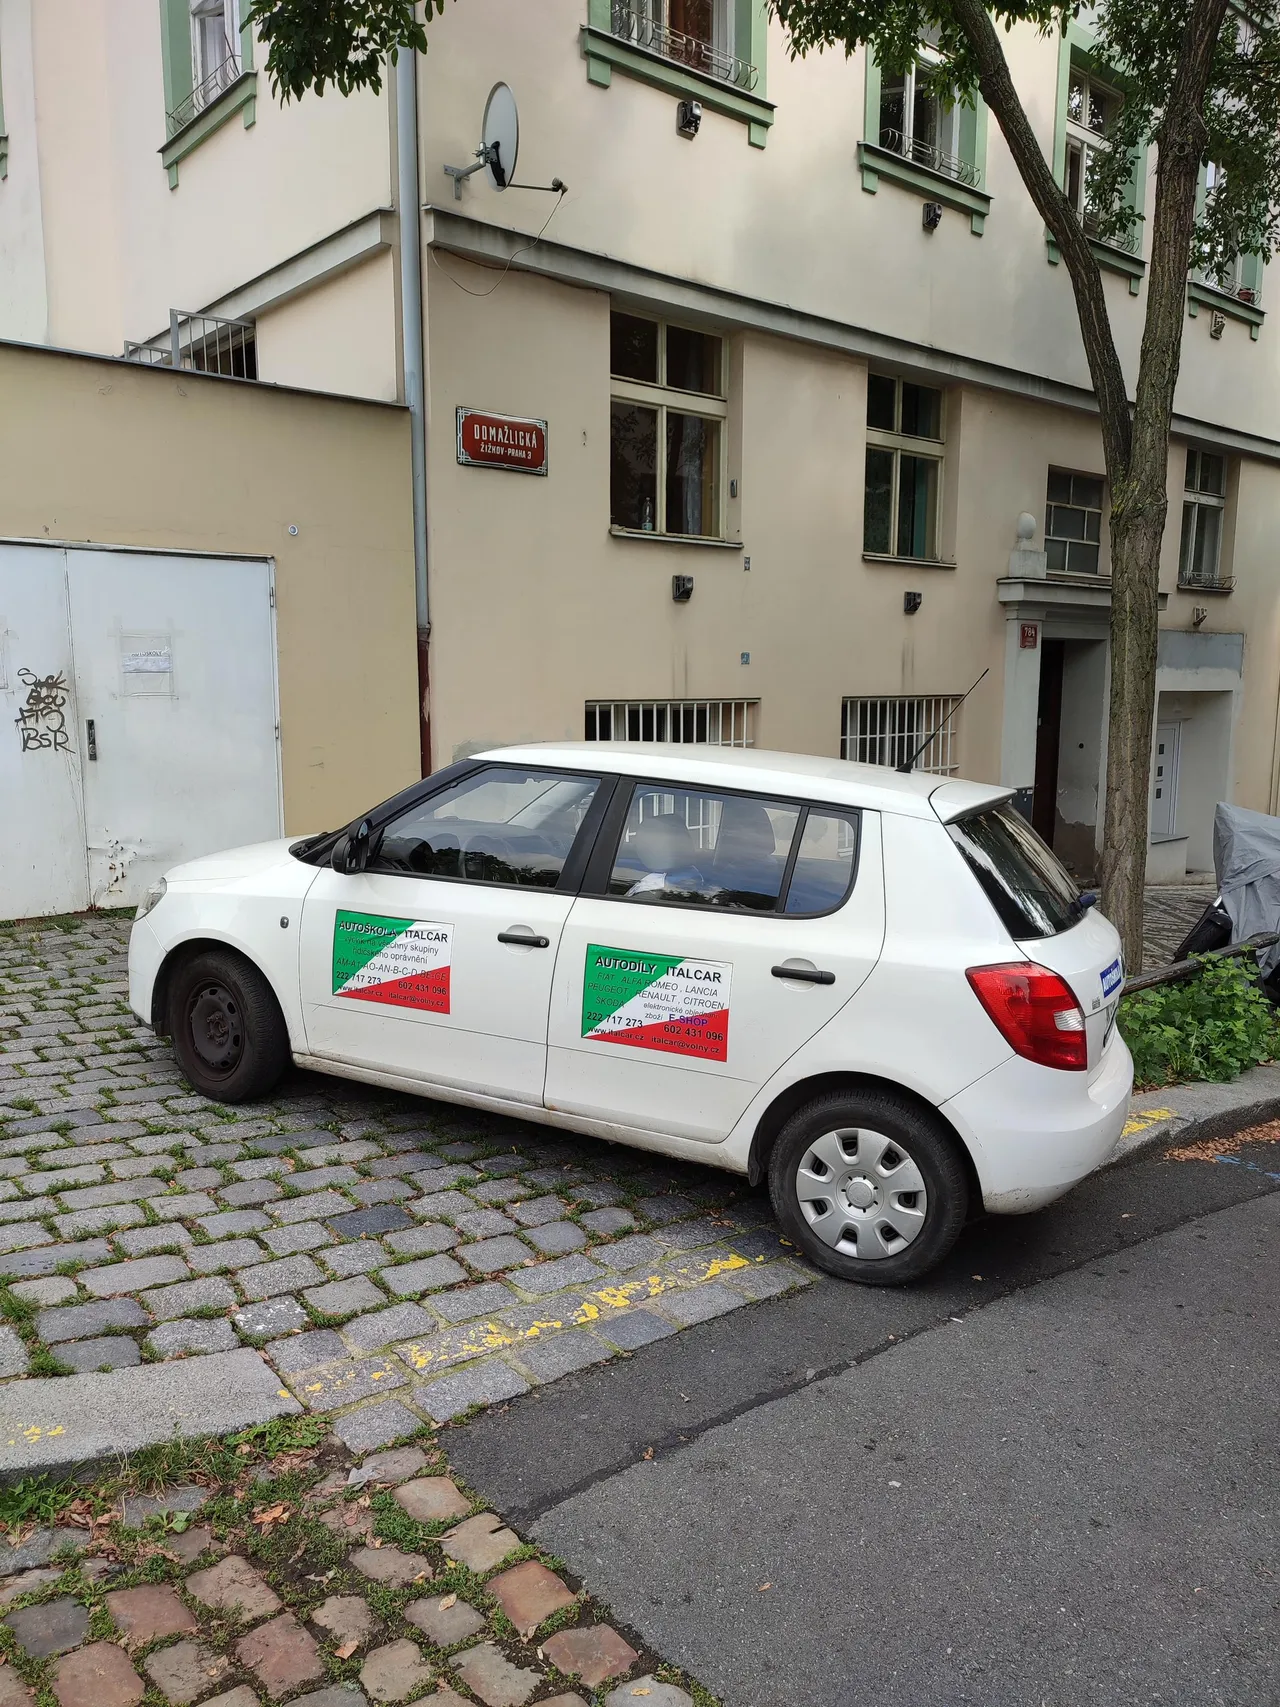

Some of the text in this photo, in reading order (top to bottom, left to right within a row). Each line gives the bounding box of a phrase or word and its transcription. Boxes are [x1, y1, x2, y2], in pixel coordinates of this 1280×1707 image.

[474, 424, 537, 448] DOMAŽLICKÁ
[527, 452, 532, 460] 3
[1024, 627, 1035, 637] 784
[340, 921, 448, 942] AUTOŠKOLA ITALCAR
[410, 944, 439, 956] skupiny
[390, 952, 428, 964] oprávnění
[596, 956, 722, 983] AUTODÍLY ITALCAR
[336, 970, 382, 985] 222 717 273
[597, 972, 718, 997] FIAT ALFA ROMEO LANCIA
[338, 985, 383, 997] www.italcar.cz
[398, 981, 447, 995] 602 431 096
[389, 992, 444, 1007] italcar@volny.cz
[588, 983, 725, 1010] PEUGEOT RENAULT CITROEN
[596, 996, 625, 1008] ŠKODA
[643, 1002, 683, 1014] elektronické
[587, 1011, 643, 1028] 222 717 273
[645, 1012, 663, 1020] zboží
[588, 1026, 644, 1040] www.italcar.cz
[664, 1025, 723, 1041] 602 431 096
[652, 1036, 720, 1053] italcar@volny.cz
